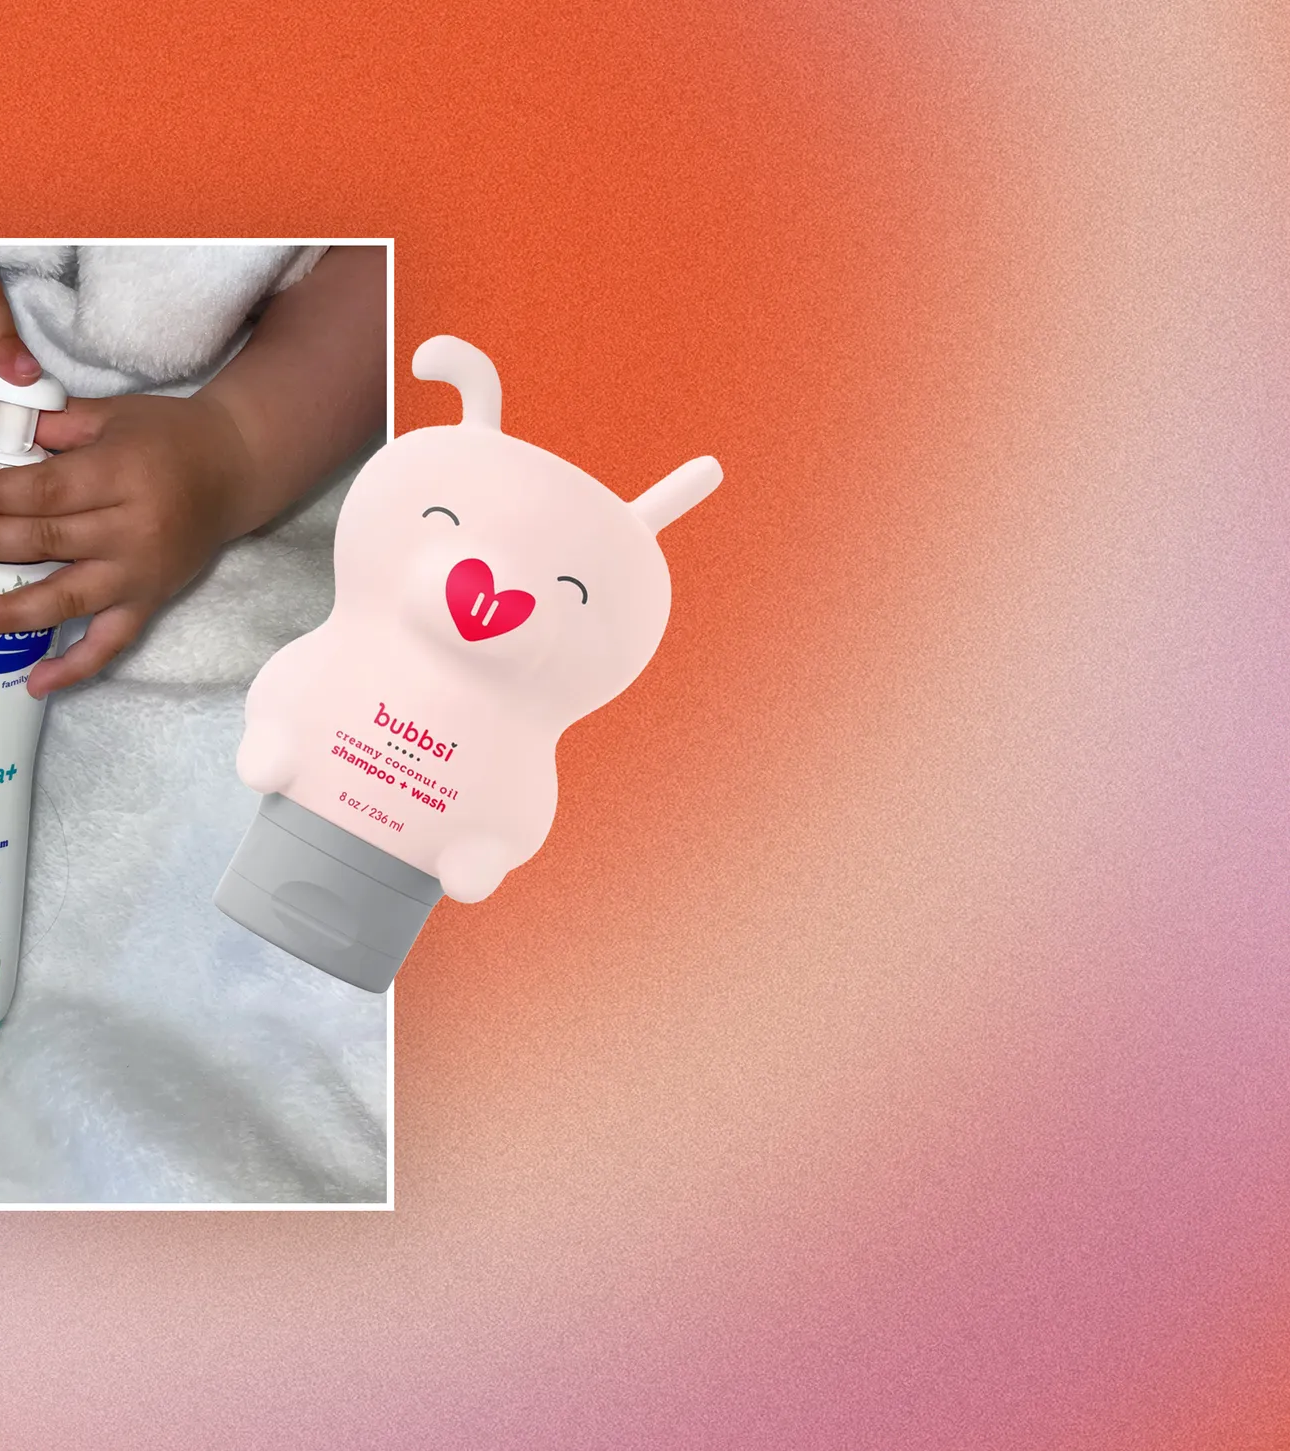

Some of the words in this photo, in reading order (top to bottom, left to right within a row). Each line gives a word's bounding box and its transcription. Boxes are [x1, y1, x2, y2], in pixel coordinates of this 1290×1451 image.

[2, 675, 29, 688] family
[373, 702, 457, 762] bubbsi
[331, 744, 395, 784] shampoo
[411, 787, 446, 813] wash
[336, 730, 382, 759] creamy
[385, 757, 437, 789] coconut
[440, 786, 458, 800] oil
[339, 792, 347, 801] 8
[348, 798, 360, 810] oz
[369, 808, 388, 825] 236
[389, 821, 404, 832] ml
